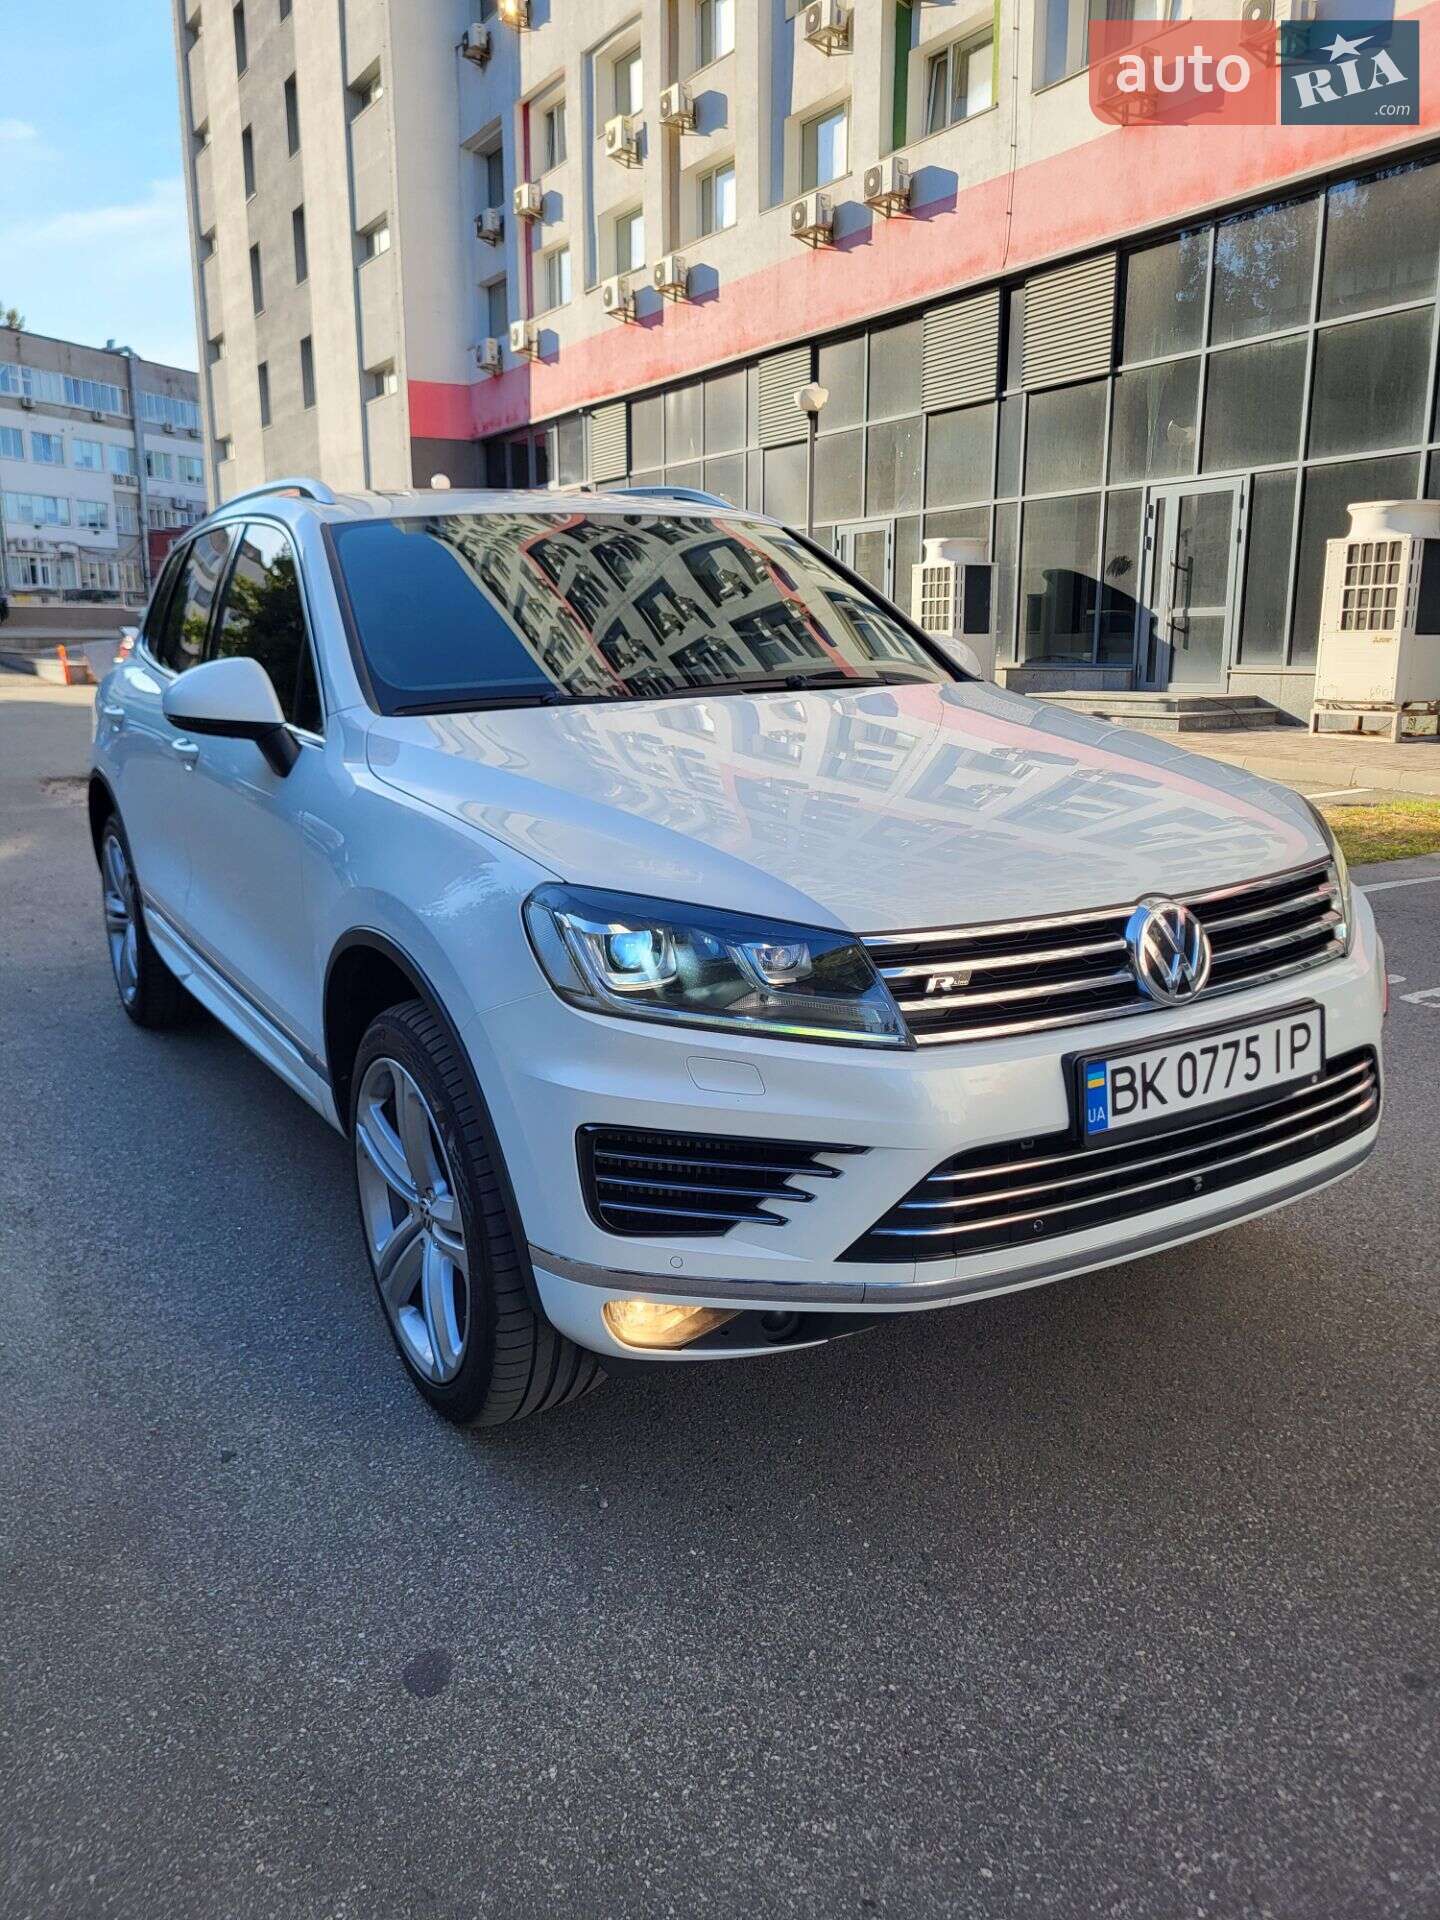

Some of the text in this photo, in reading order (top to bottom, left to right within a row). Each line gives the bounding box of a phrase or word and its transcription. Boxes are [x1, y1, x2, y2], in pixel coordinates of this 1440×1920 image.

[1110, 1022, 1312, 1117] BK 0775 IP
[1088, 1106, 1106, 1123] UA
